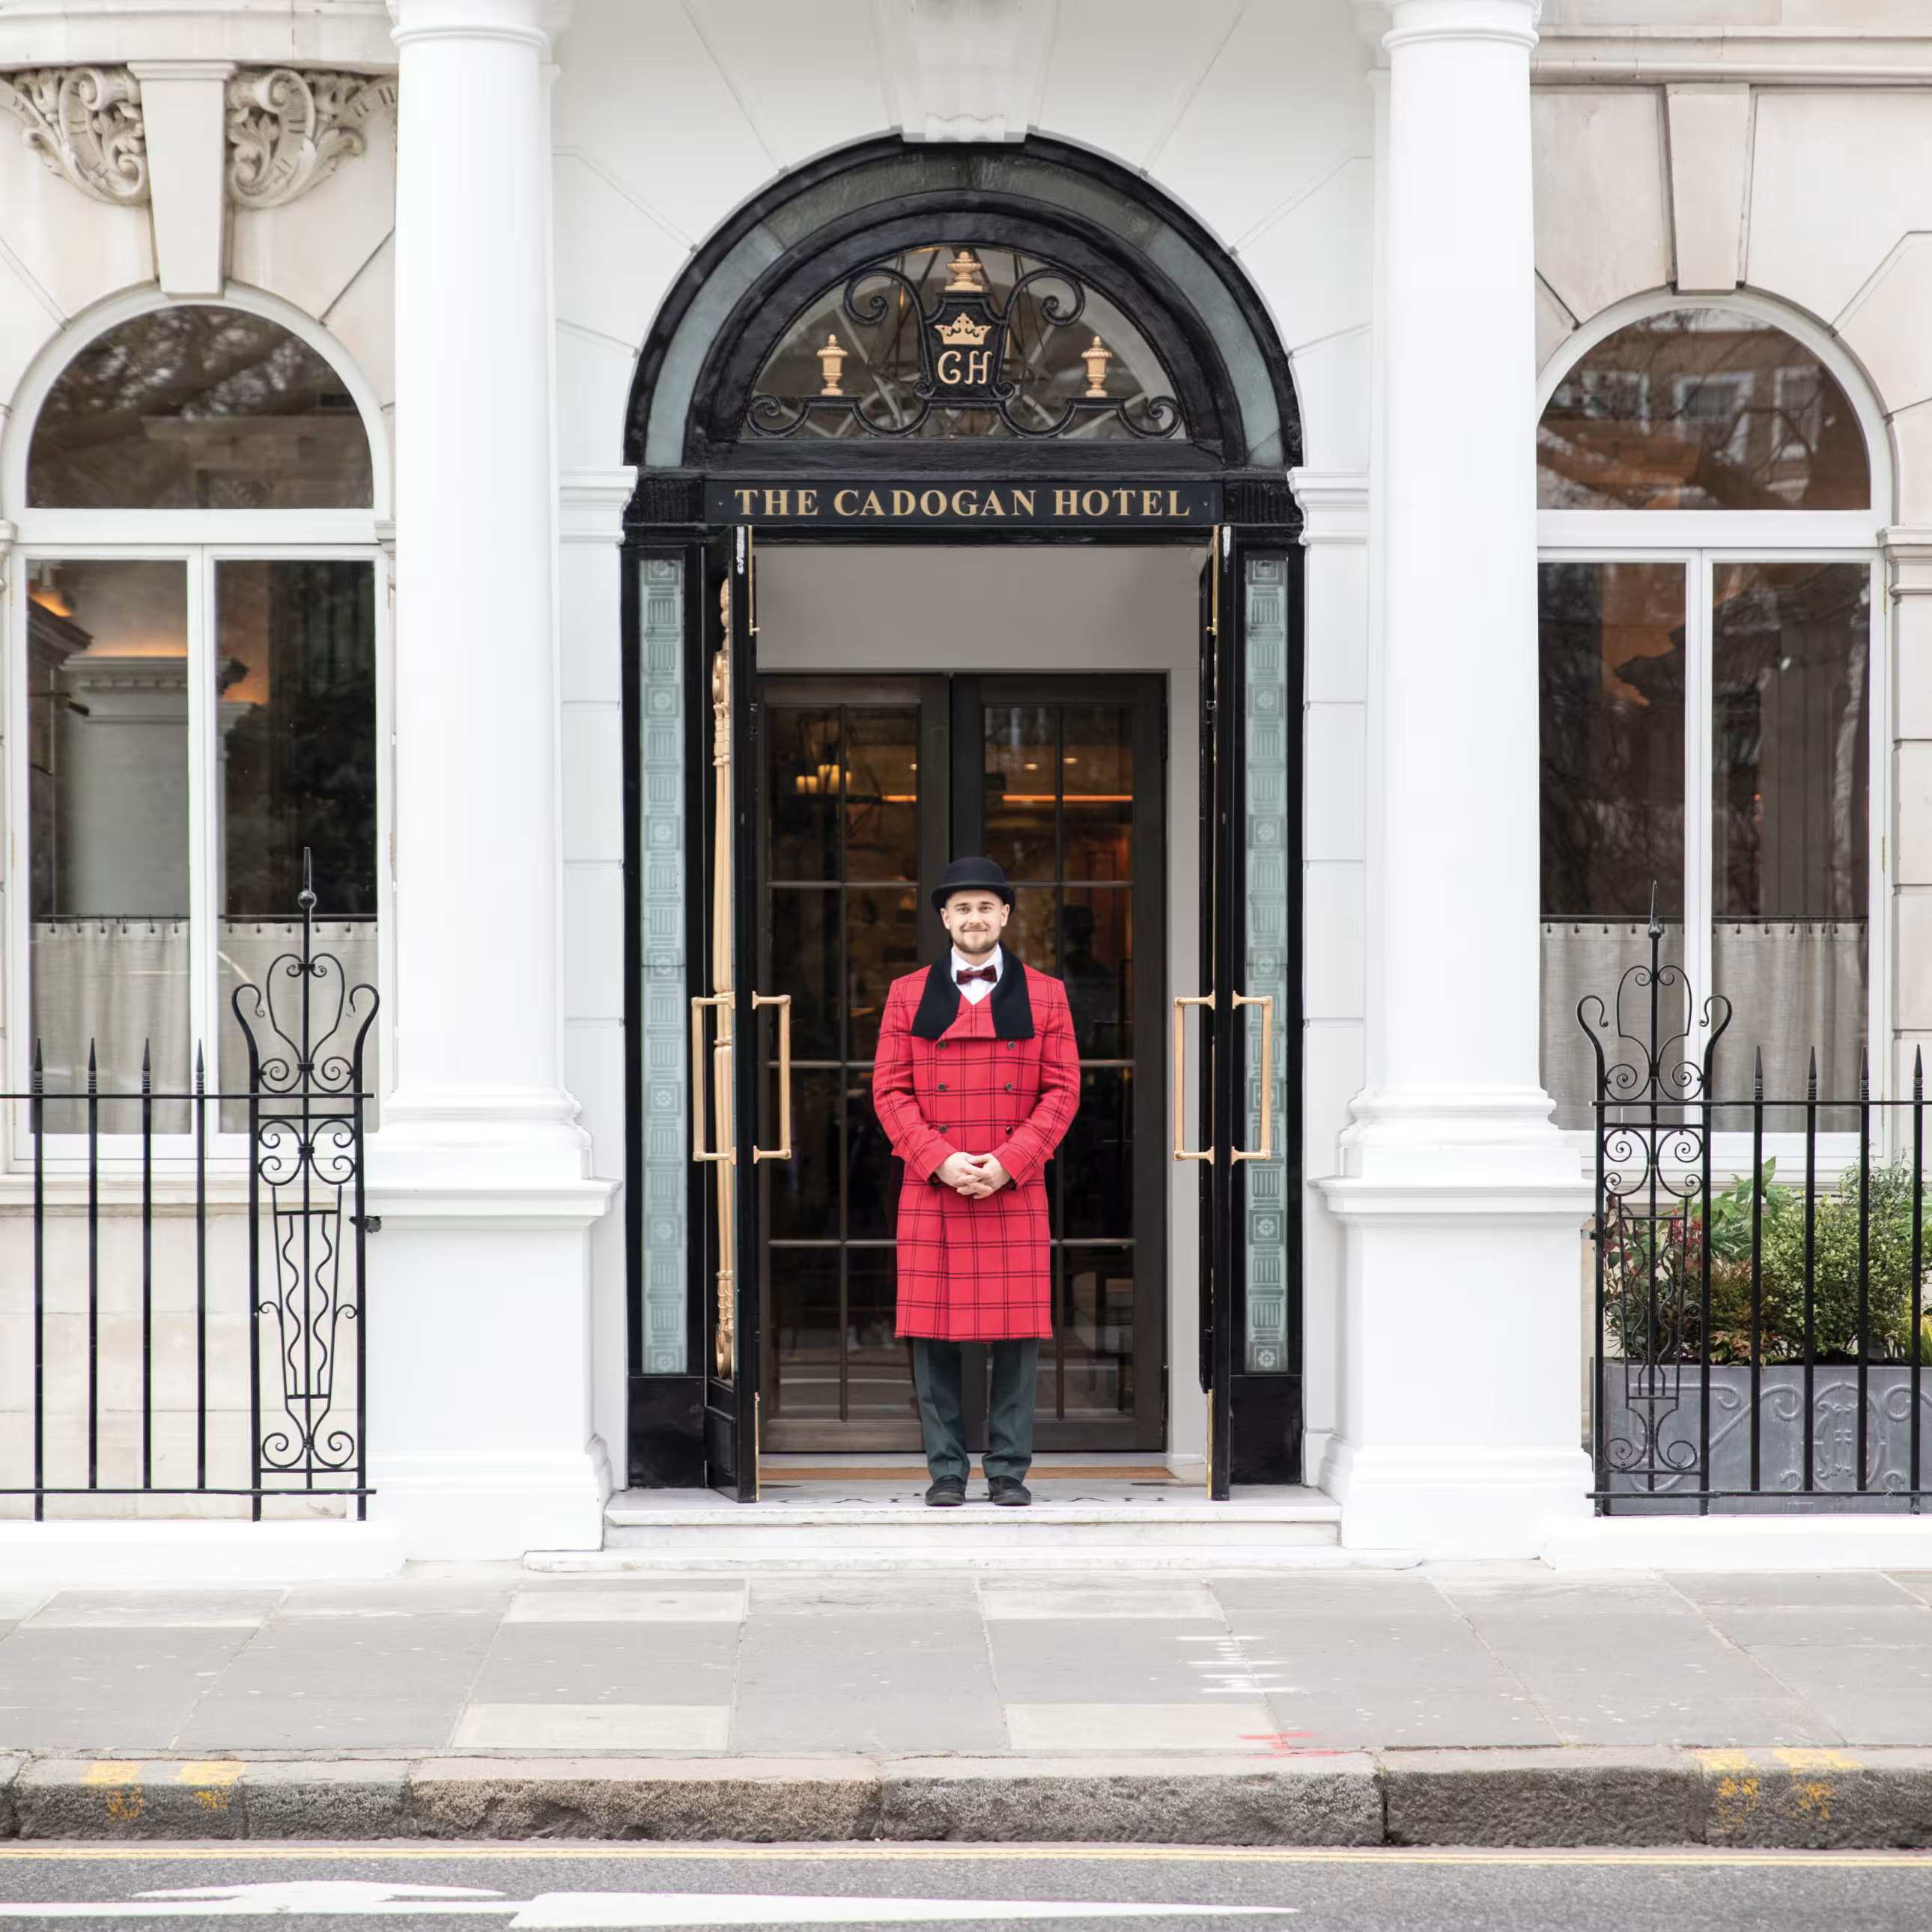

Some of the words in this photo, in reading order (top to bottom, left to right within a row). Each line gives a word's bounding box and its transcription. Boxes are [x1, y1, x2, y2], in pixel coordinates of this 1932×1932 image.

[735, 489, 818, 515] THE
[833, 489, 1036, 516] CADOGAN
[1053, 489, 1190, 515] HOTEL
